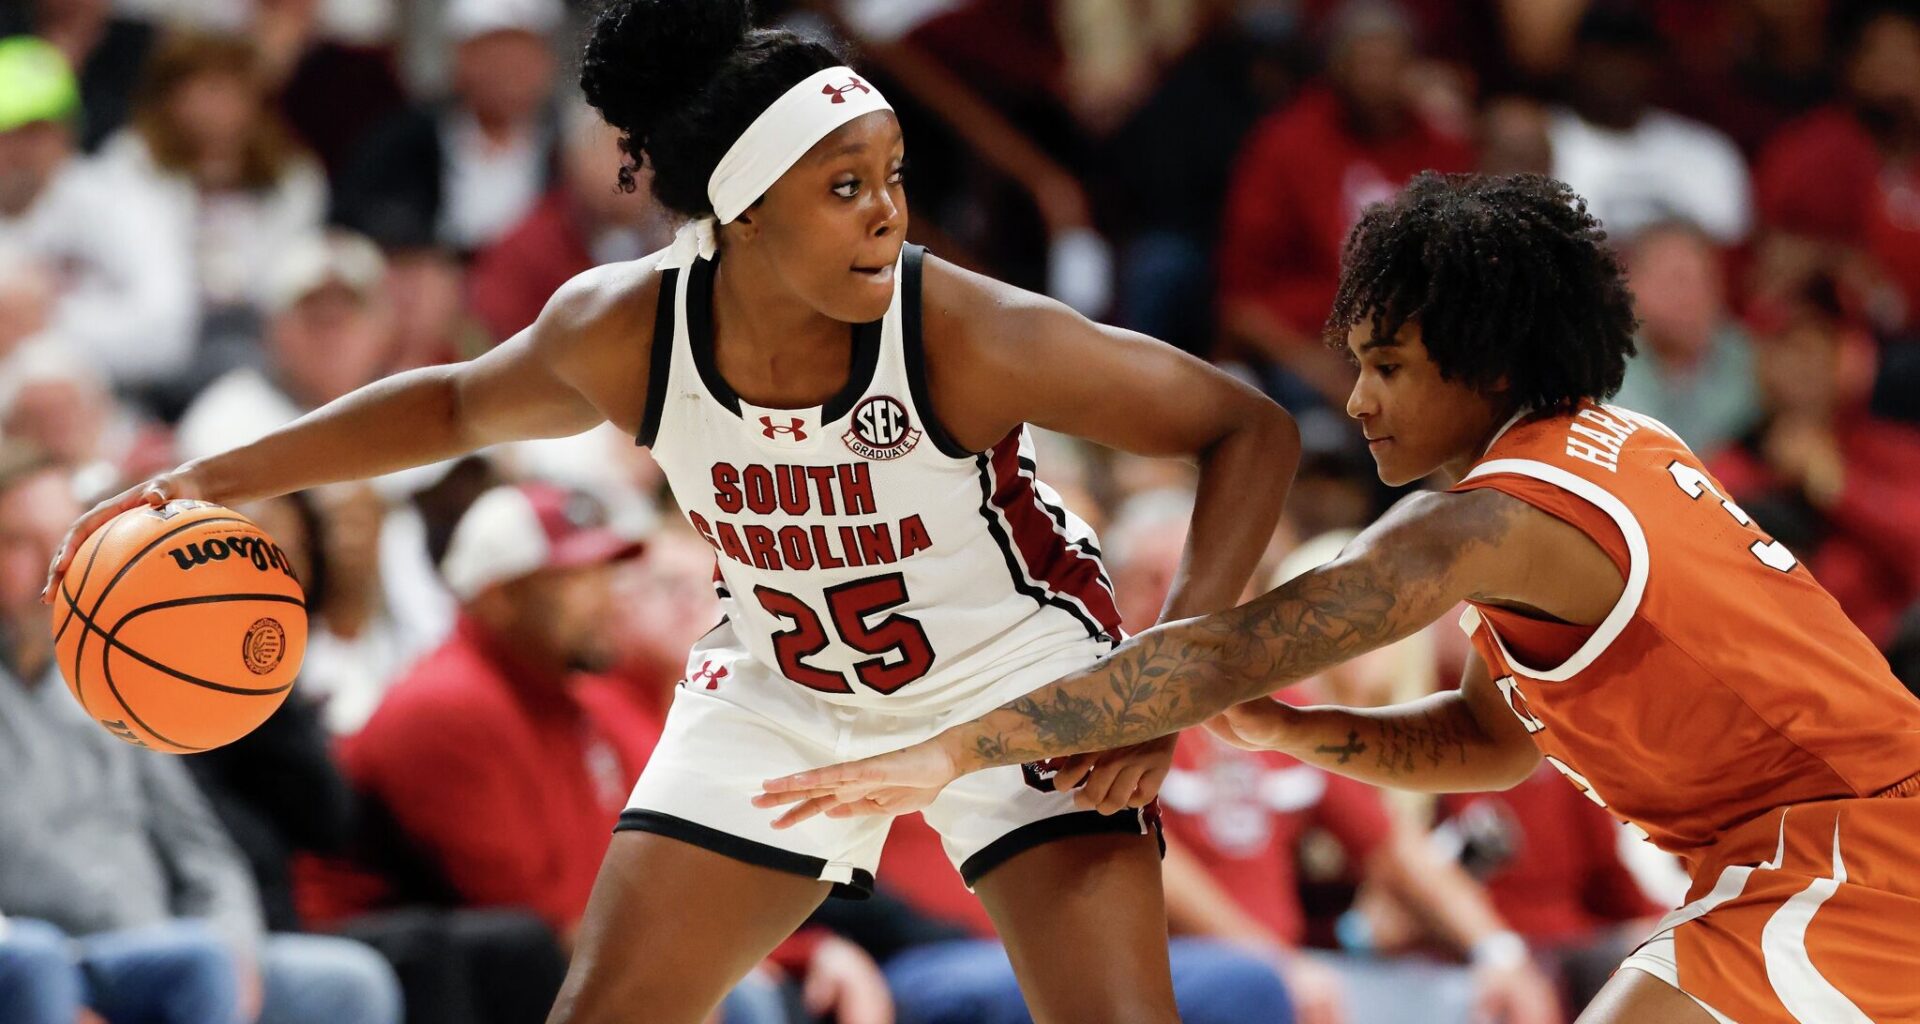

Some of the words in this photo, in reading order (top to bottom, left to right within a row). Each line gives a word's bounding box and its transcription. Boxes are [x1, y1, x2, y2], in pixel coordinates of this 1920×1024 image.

[852, 440, 914, 459] GRADUATE
[857, 400, 904, 445] SEC
[711, 461, 878, 516] SOUTH
[689, 509, 934, 571] CAROLINA
[754, 572, 936, 696] 25
